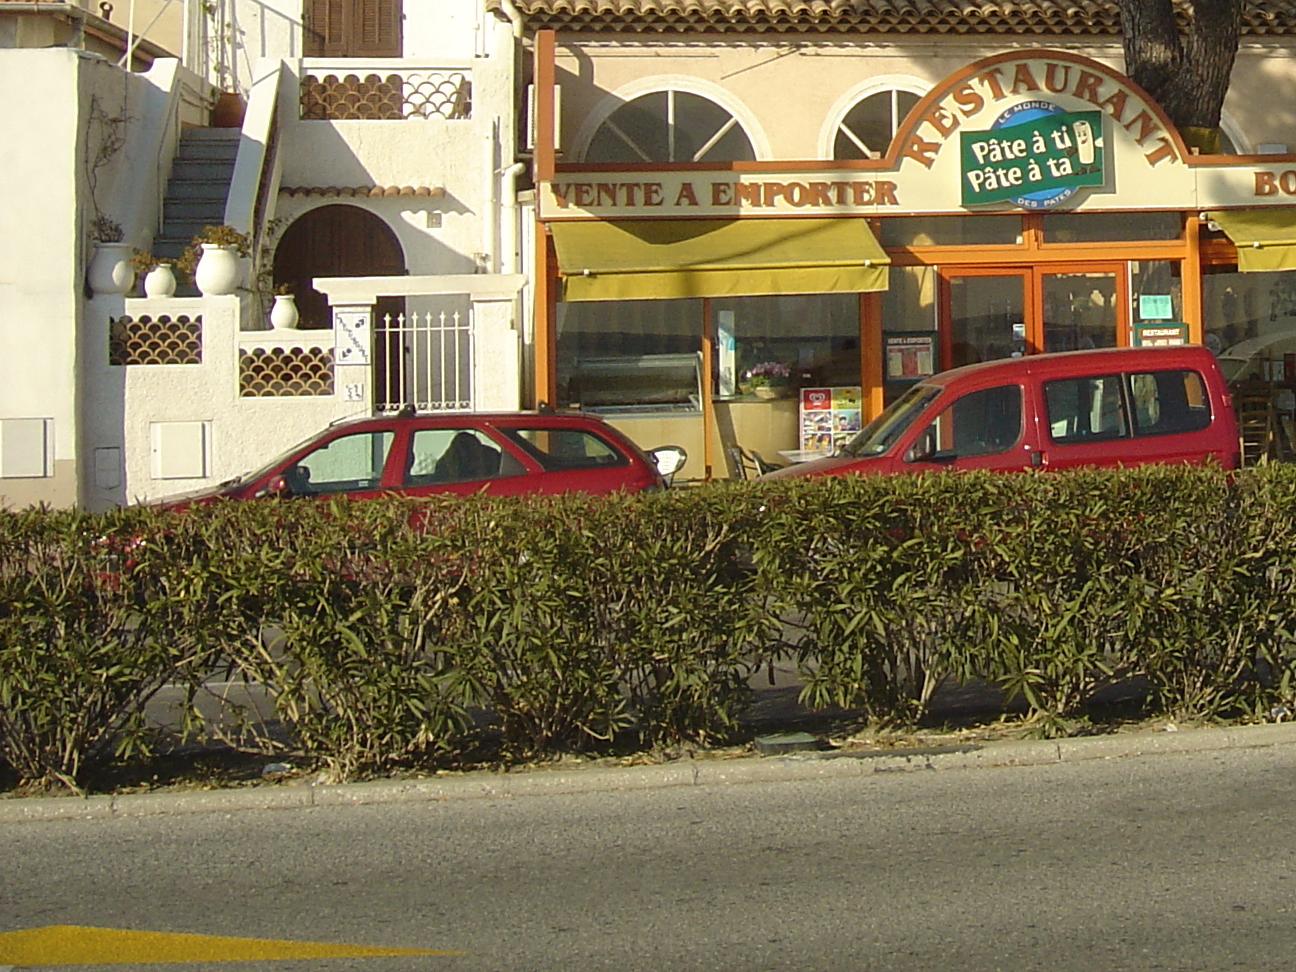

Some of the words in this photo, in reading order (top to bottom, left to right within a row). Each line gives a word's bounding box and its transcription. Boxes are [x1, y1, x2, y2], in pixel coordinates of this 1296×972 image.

[902, 61, 1180, 170] RESTAURANT
[998, 111, 1012, 124] LE
[1013, 101, 1056, 112] MONDE
[971, 138, 1027, 165] Pâte
[1032, 130, 1047, 154] à
[1051, 125, 1073, 150] ti
[966, 166, 1023, 193] Pâte
[1028, 158, 1043, 182] à
[1046, 157, 1073, 178] ta
[551, 180, 665, 209] VENTE
[674, 181, 698, 207] A
[711, 179, 899, 208] EMPORTER
[1017, 198, 1038, 208] DES
[1043, 188, 1072, 208] PATES
